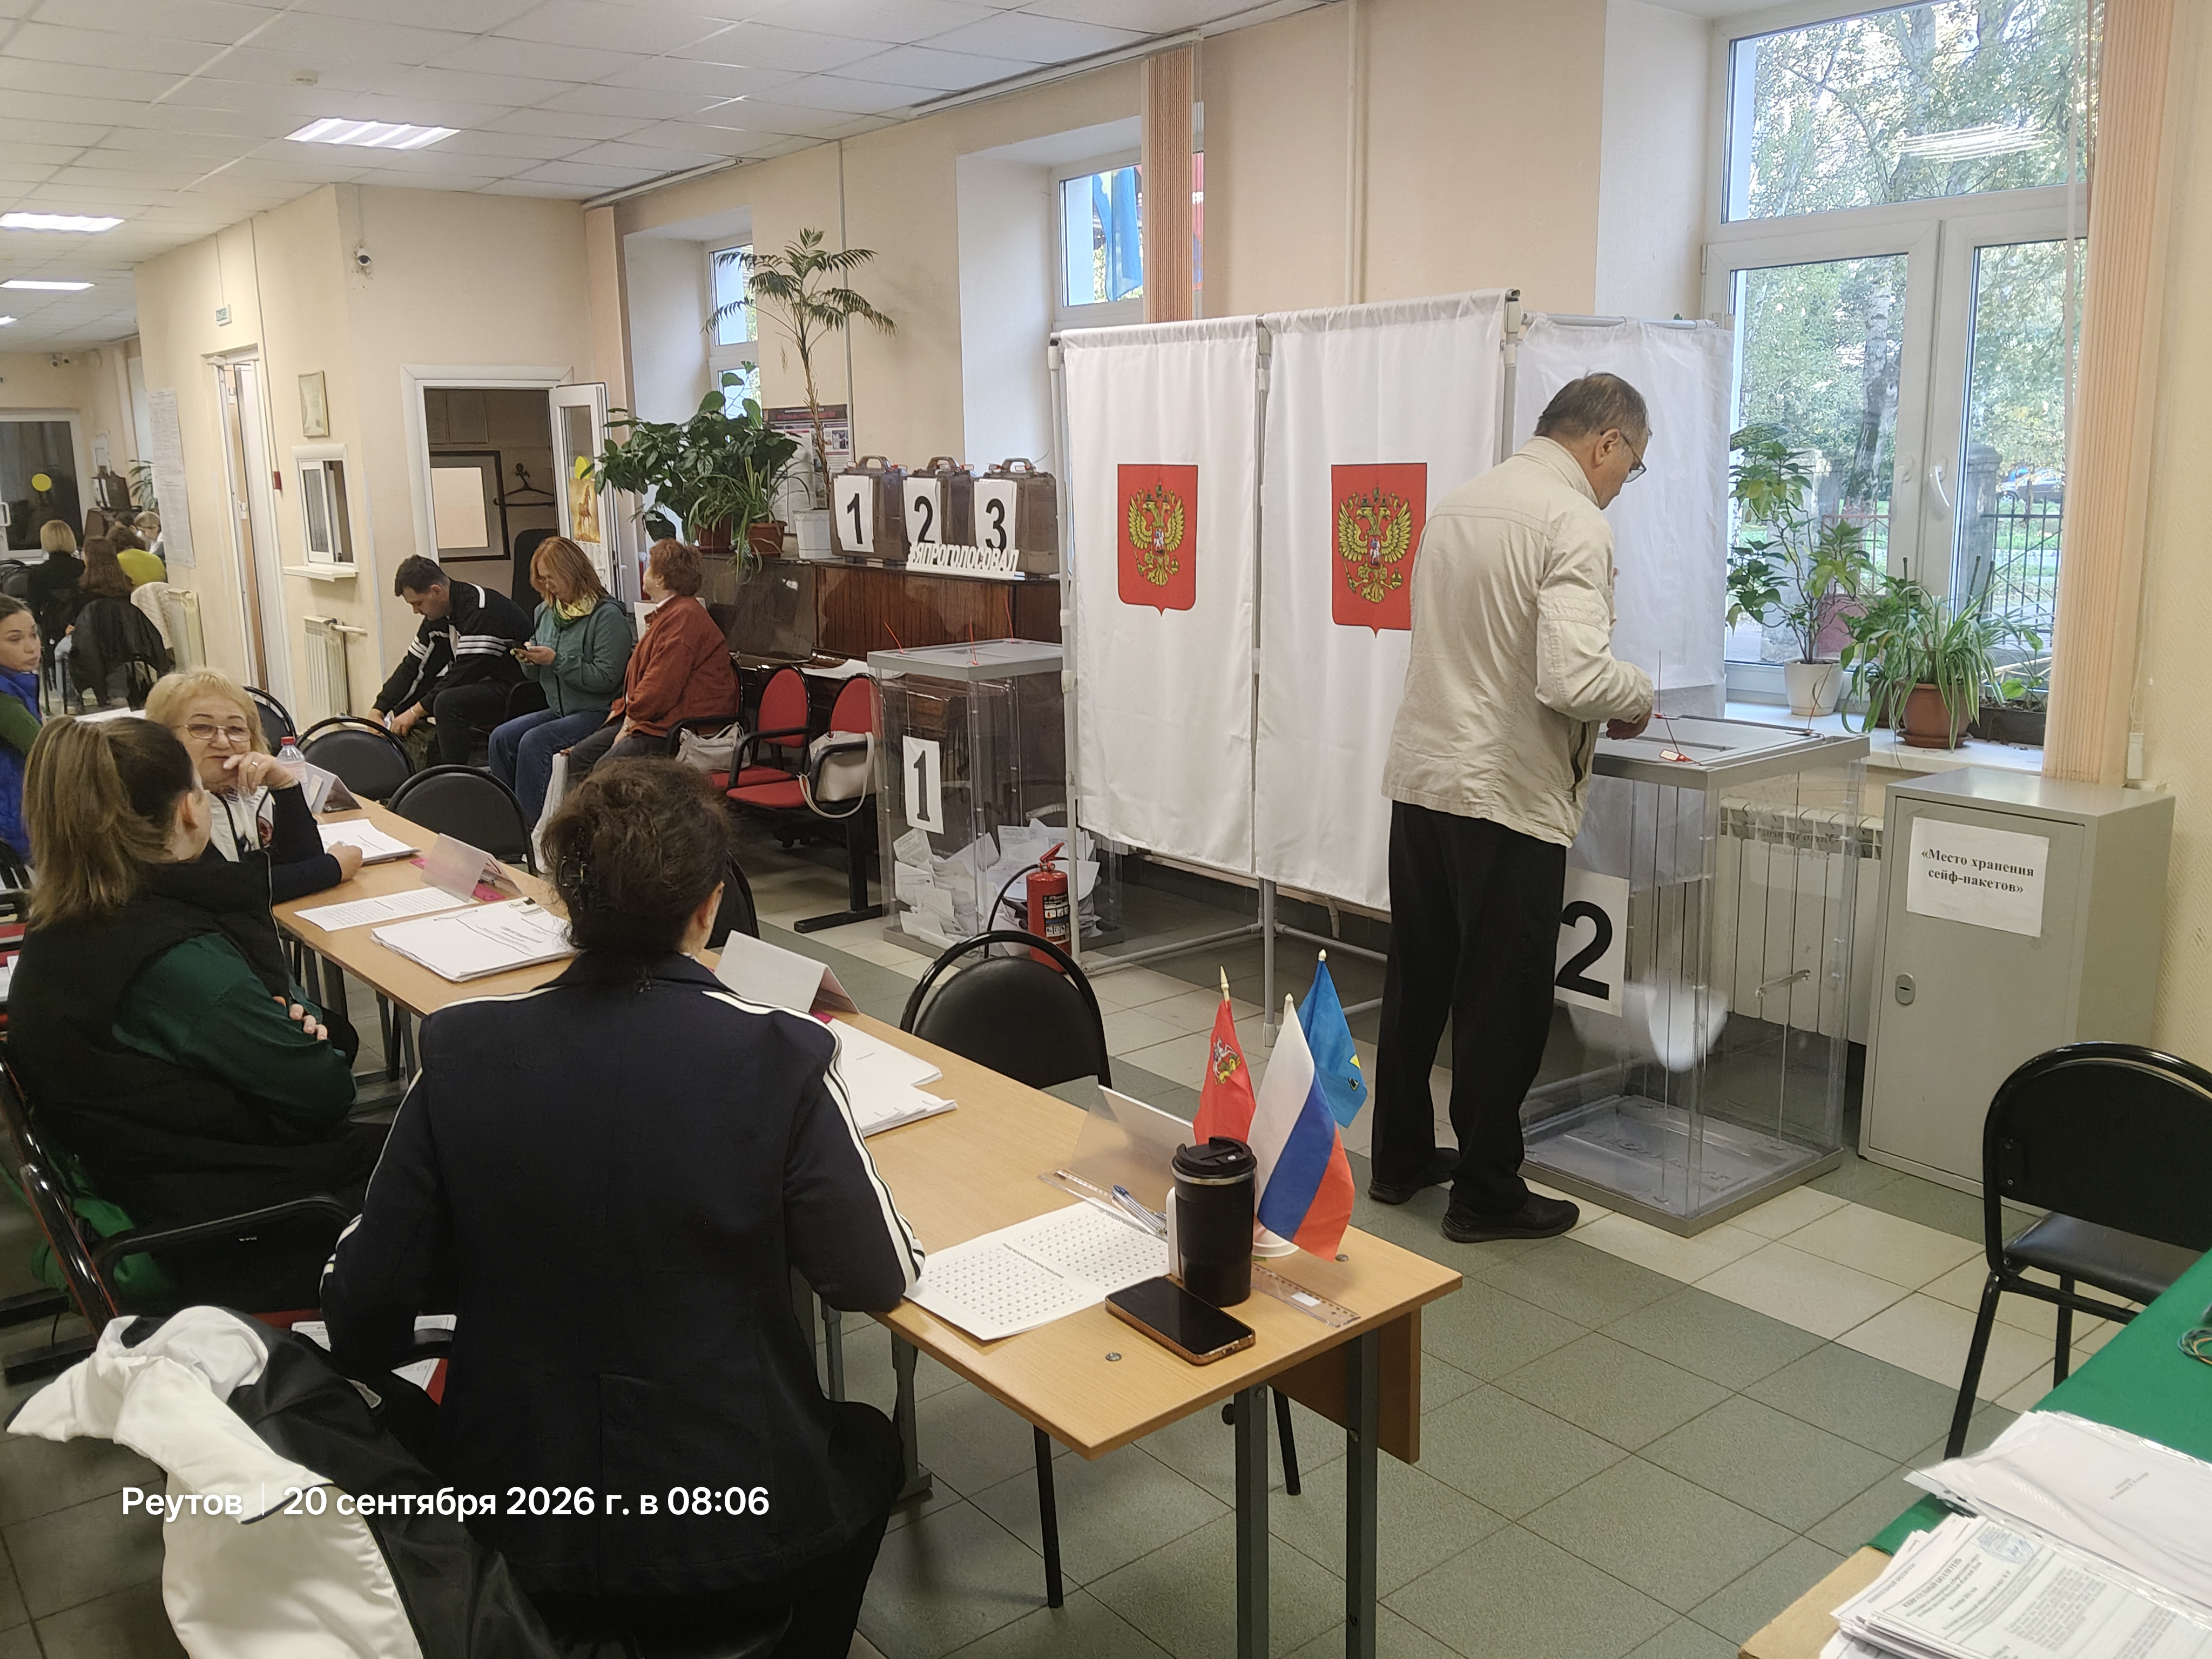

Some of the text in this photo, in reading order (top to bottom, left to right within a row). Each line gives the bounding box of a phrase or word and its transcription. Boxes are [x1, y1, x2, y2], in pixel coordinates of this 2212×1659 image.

[847, 493, 863, 544] 1
[914, 495, 935, 543] 2
[985, 498, 1007, 551] 3
[913, 750, 930, 822] 1
[1921, 848, 2034, 877] «Место хранения
[1928, 869, 2024, 893] сейф-пакетов»
[1554, 900, 1613, 1001] 2
